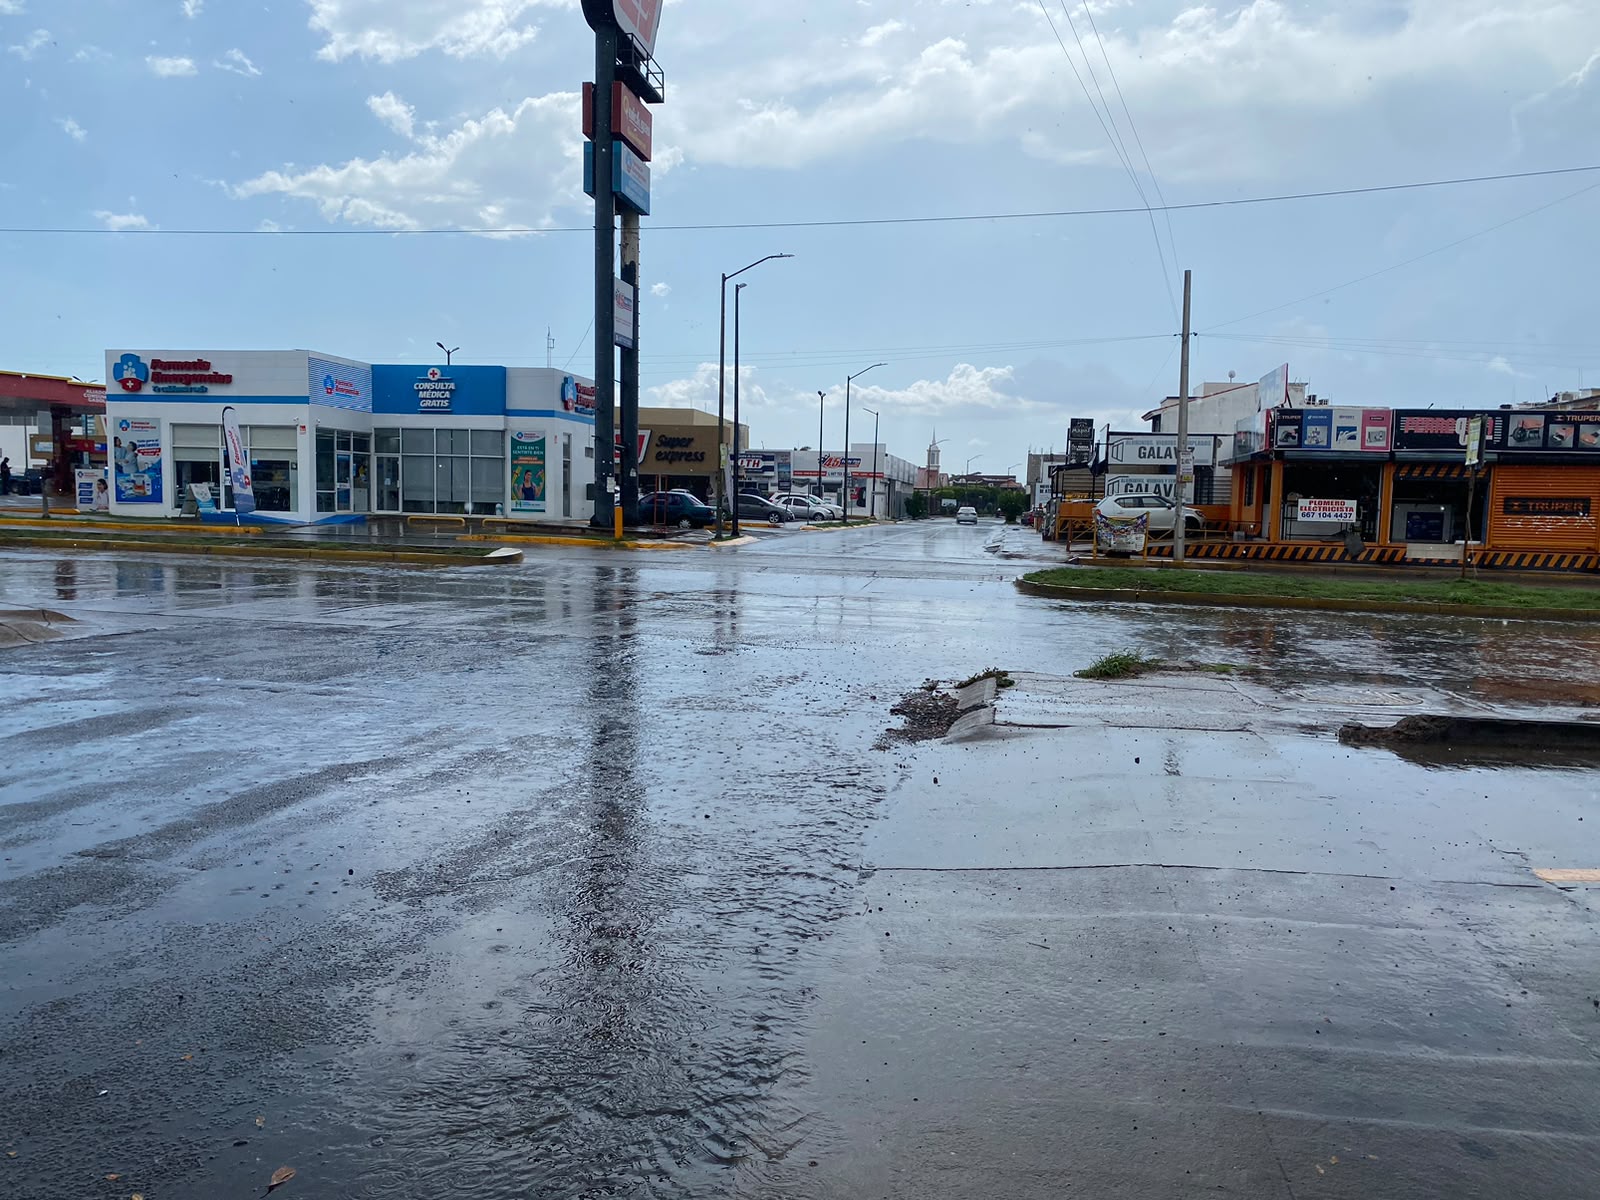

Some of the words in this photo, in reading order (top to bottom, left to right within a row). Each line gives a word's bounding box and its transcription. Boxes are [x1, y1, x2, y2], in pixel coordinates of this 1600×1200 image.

[413, 382, 456, 390] CONSULTA
[418, 390, 451, 398] MÉDICA
[655, 434, 694, 449] Super
[655, 450, 706, 464] express
[1528, 502, 1584, 511] TRUPER
